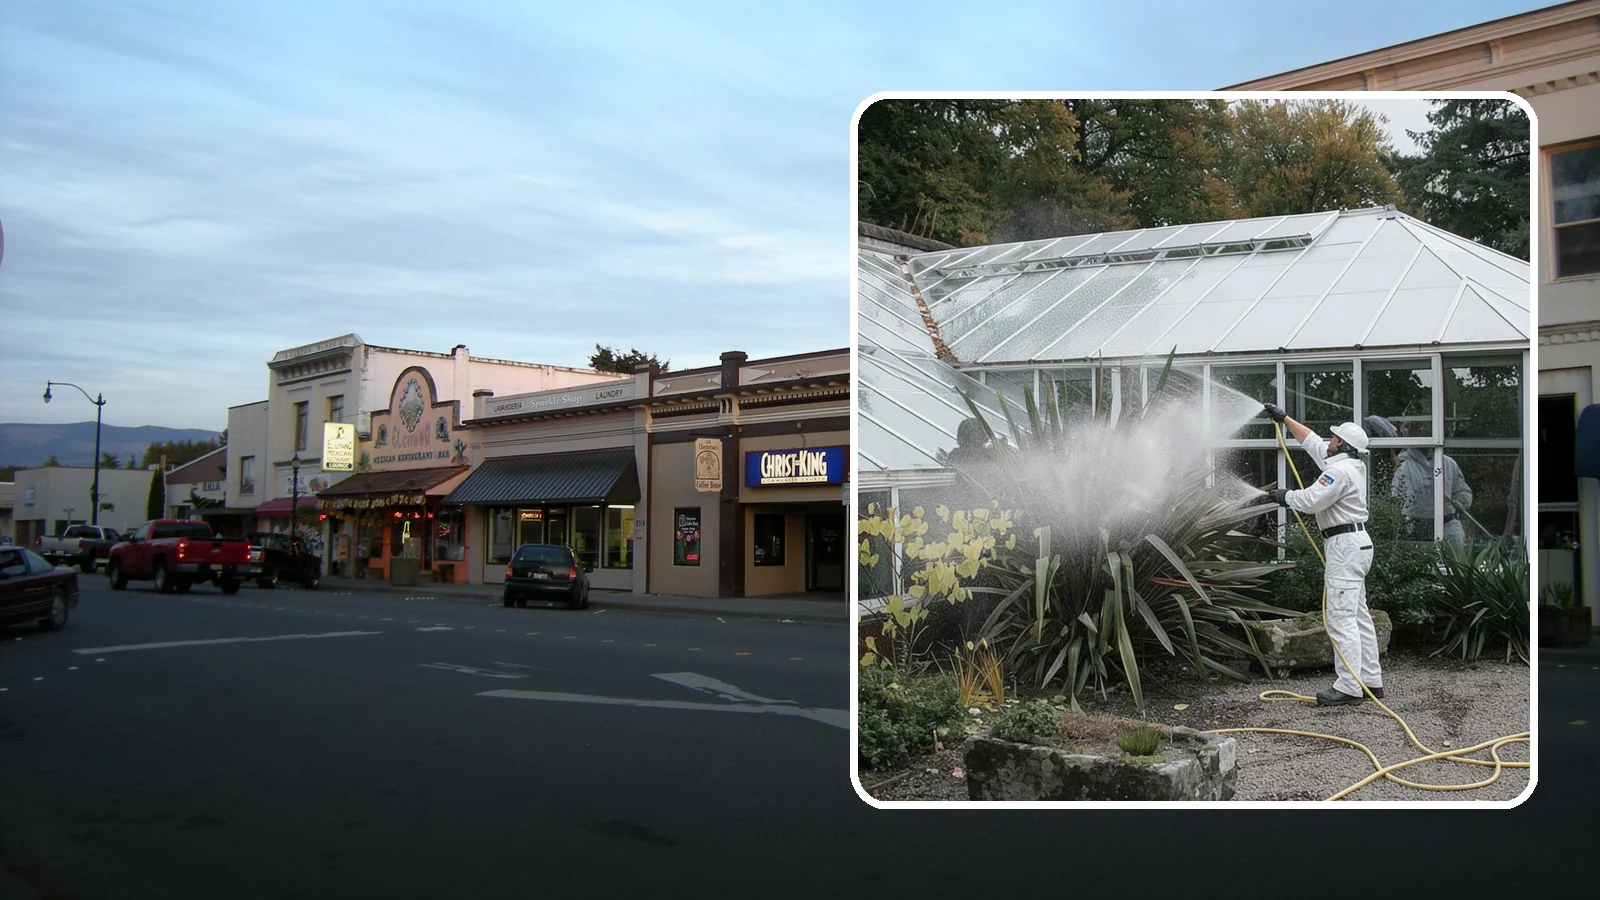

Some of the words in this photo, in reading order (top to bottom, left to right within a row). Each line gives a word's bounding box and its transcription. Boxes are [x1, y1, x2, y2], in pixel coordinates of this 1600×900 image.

[595, 389, 624, 399] LAUNDRY
[493, 402, 523, 412] LAVANDERIA
[531, 396, 561, 409] Sparkle
[562, 395, 582, 404] Shop
[374, 454, 396, 464] MEXICAN
[397, 451, 433, 462] RESTAURANT
[438, 450, 450, 459] BAR
